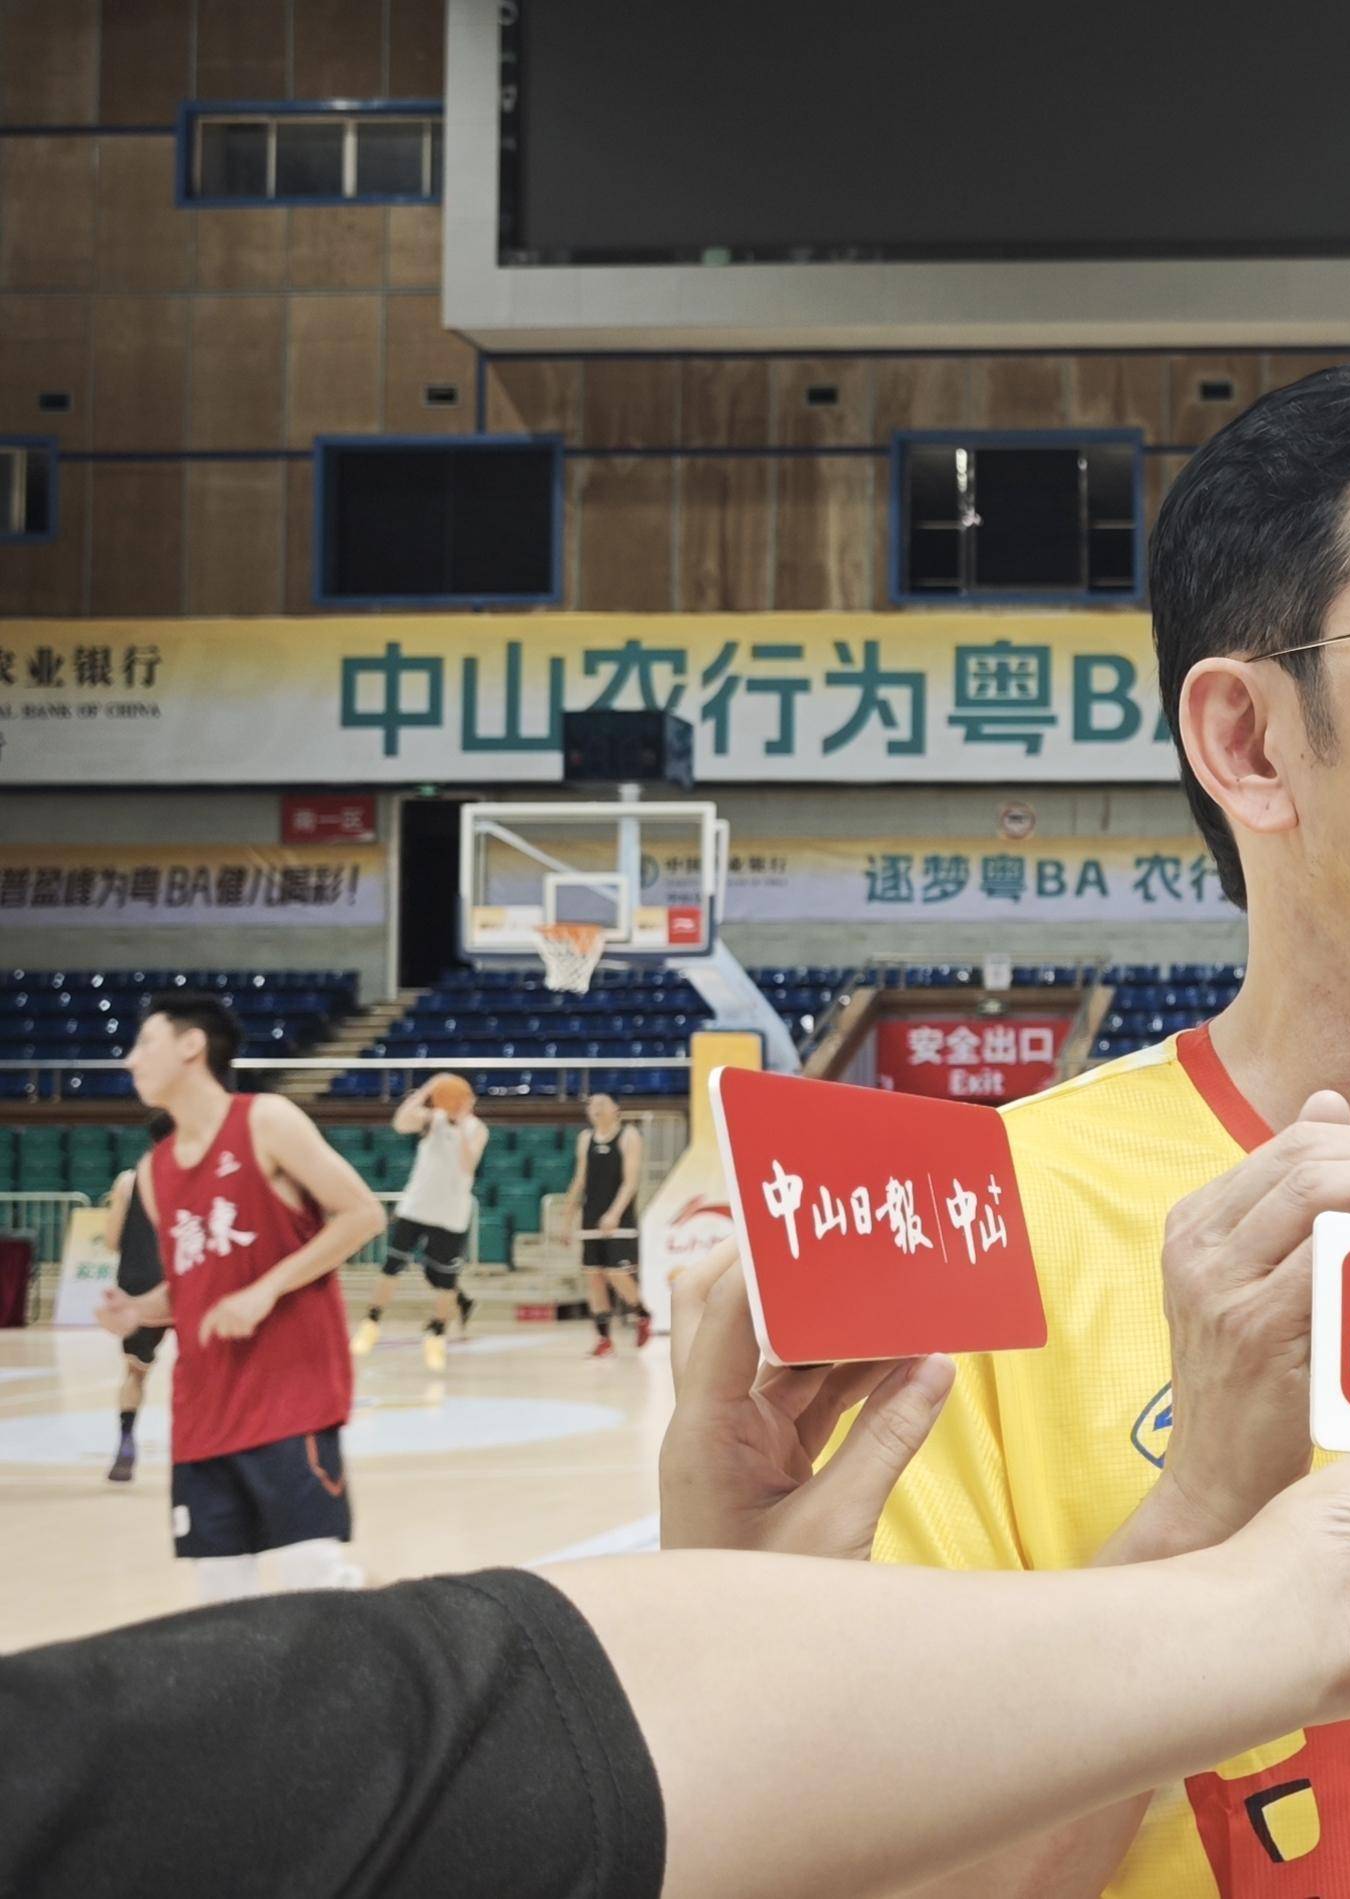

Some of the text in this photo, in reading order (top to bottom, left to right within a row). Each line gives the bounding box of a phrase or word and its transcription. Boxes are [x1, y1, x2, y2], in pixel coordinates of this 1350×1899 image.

[864, 853, 1111, 906] 逐梦粤BA
[907, 1025, 1055, 1066] 安全出口
[948, 1068, 1005, 1097] Exit
